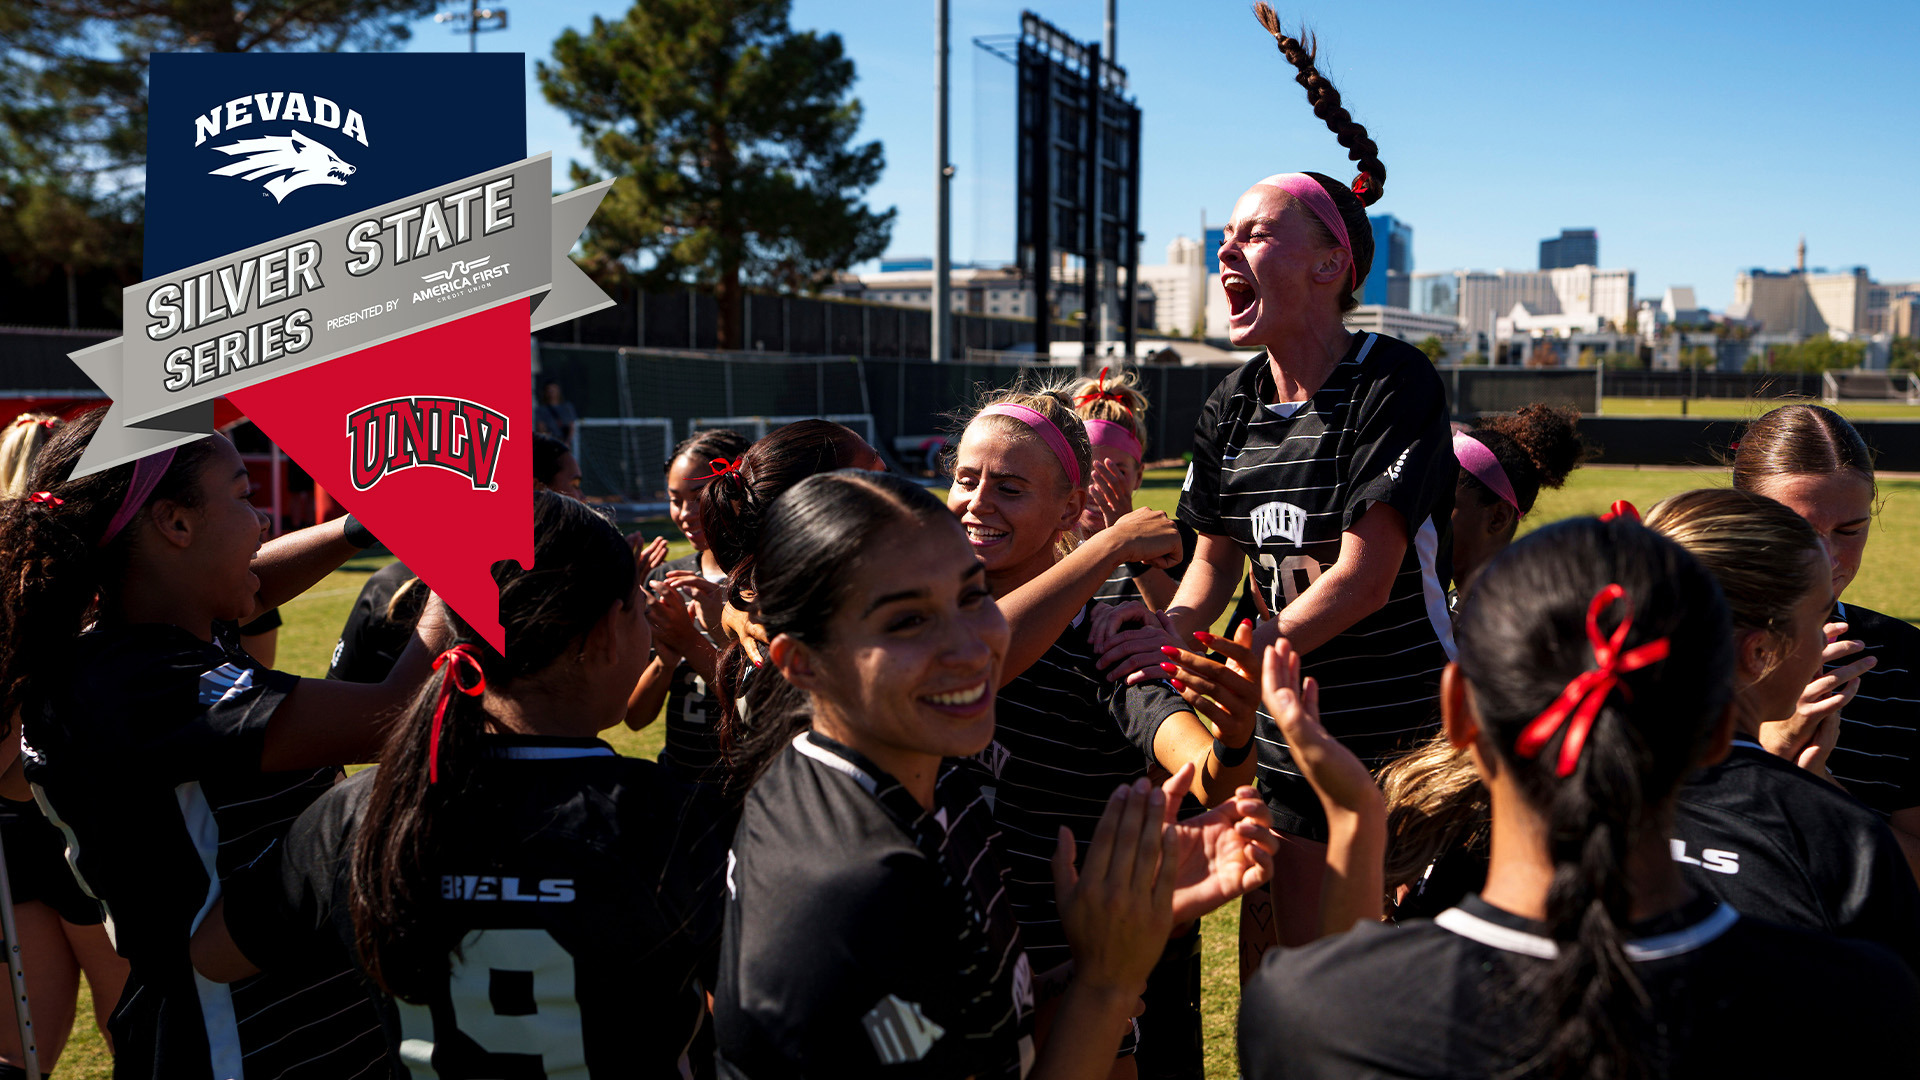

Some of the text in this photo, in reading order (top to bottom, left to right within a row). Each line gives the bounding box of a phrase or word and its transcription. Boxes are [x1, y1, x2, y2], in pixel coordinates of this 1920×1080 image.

[1250, 501, 1308, 548] UNLV
[683, 672, 706, 724] 2
[441, 875, 576, 903] BELS
